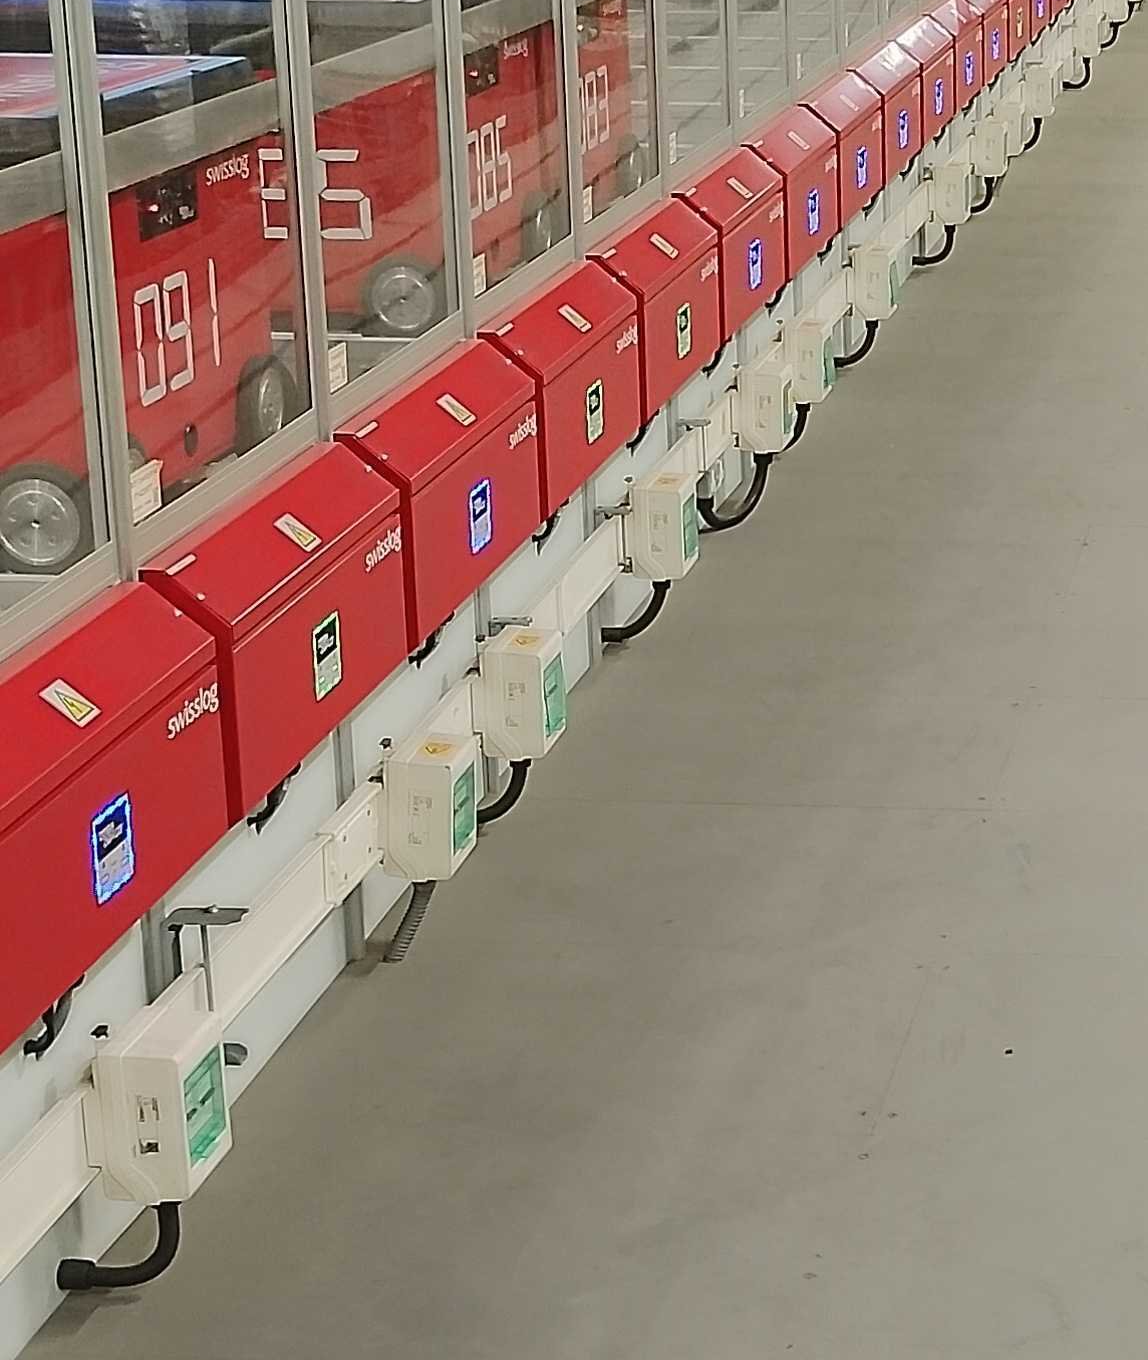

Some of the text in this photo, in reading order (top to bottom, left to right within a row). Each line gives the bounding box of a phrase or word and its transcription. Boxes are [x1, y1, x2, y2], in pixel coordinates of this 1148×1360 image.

[134, 257, 222, 407] 091
[364, 526, 402, 573] swisslog
[167, 682, 220, 740] swisslog
